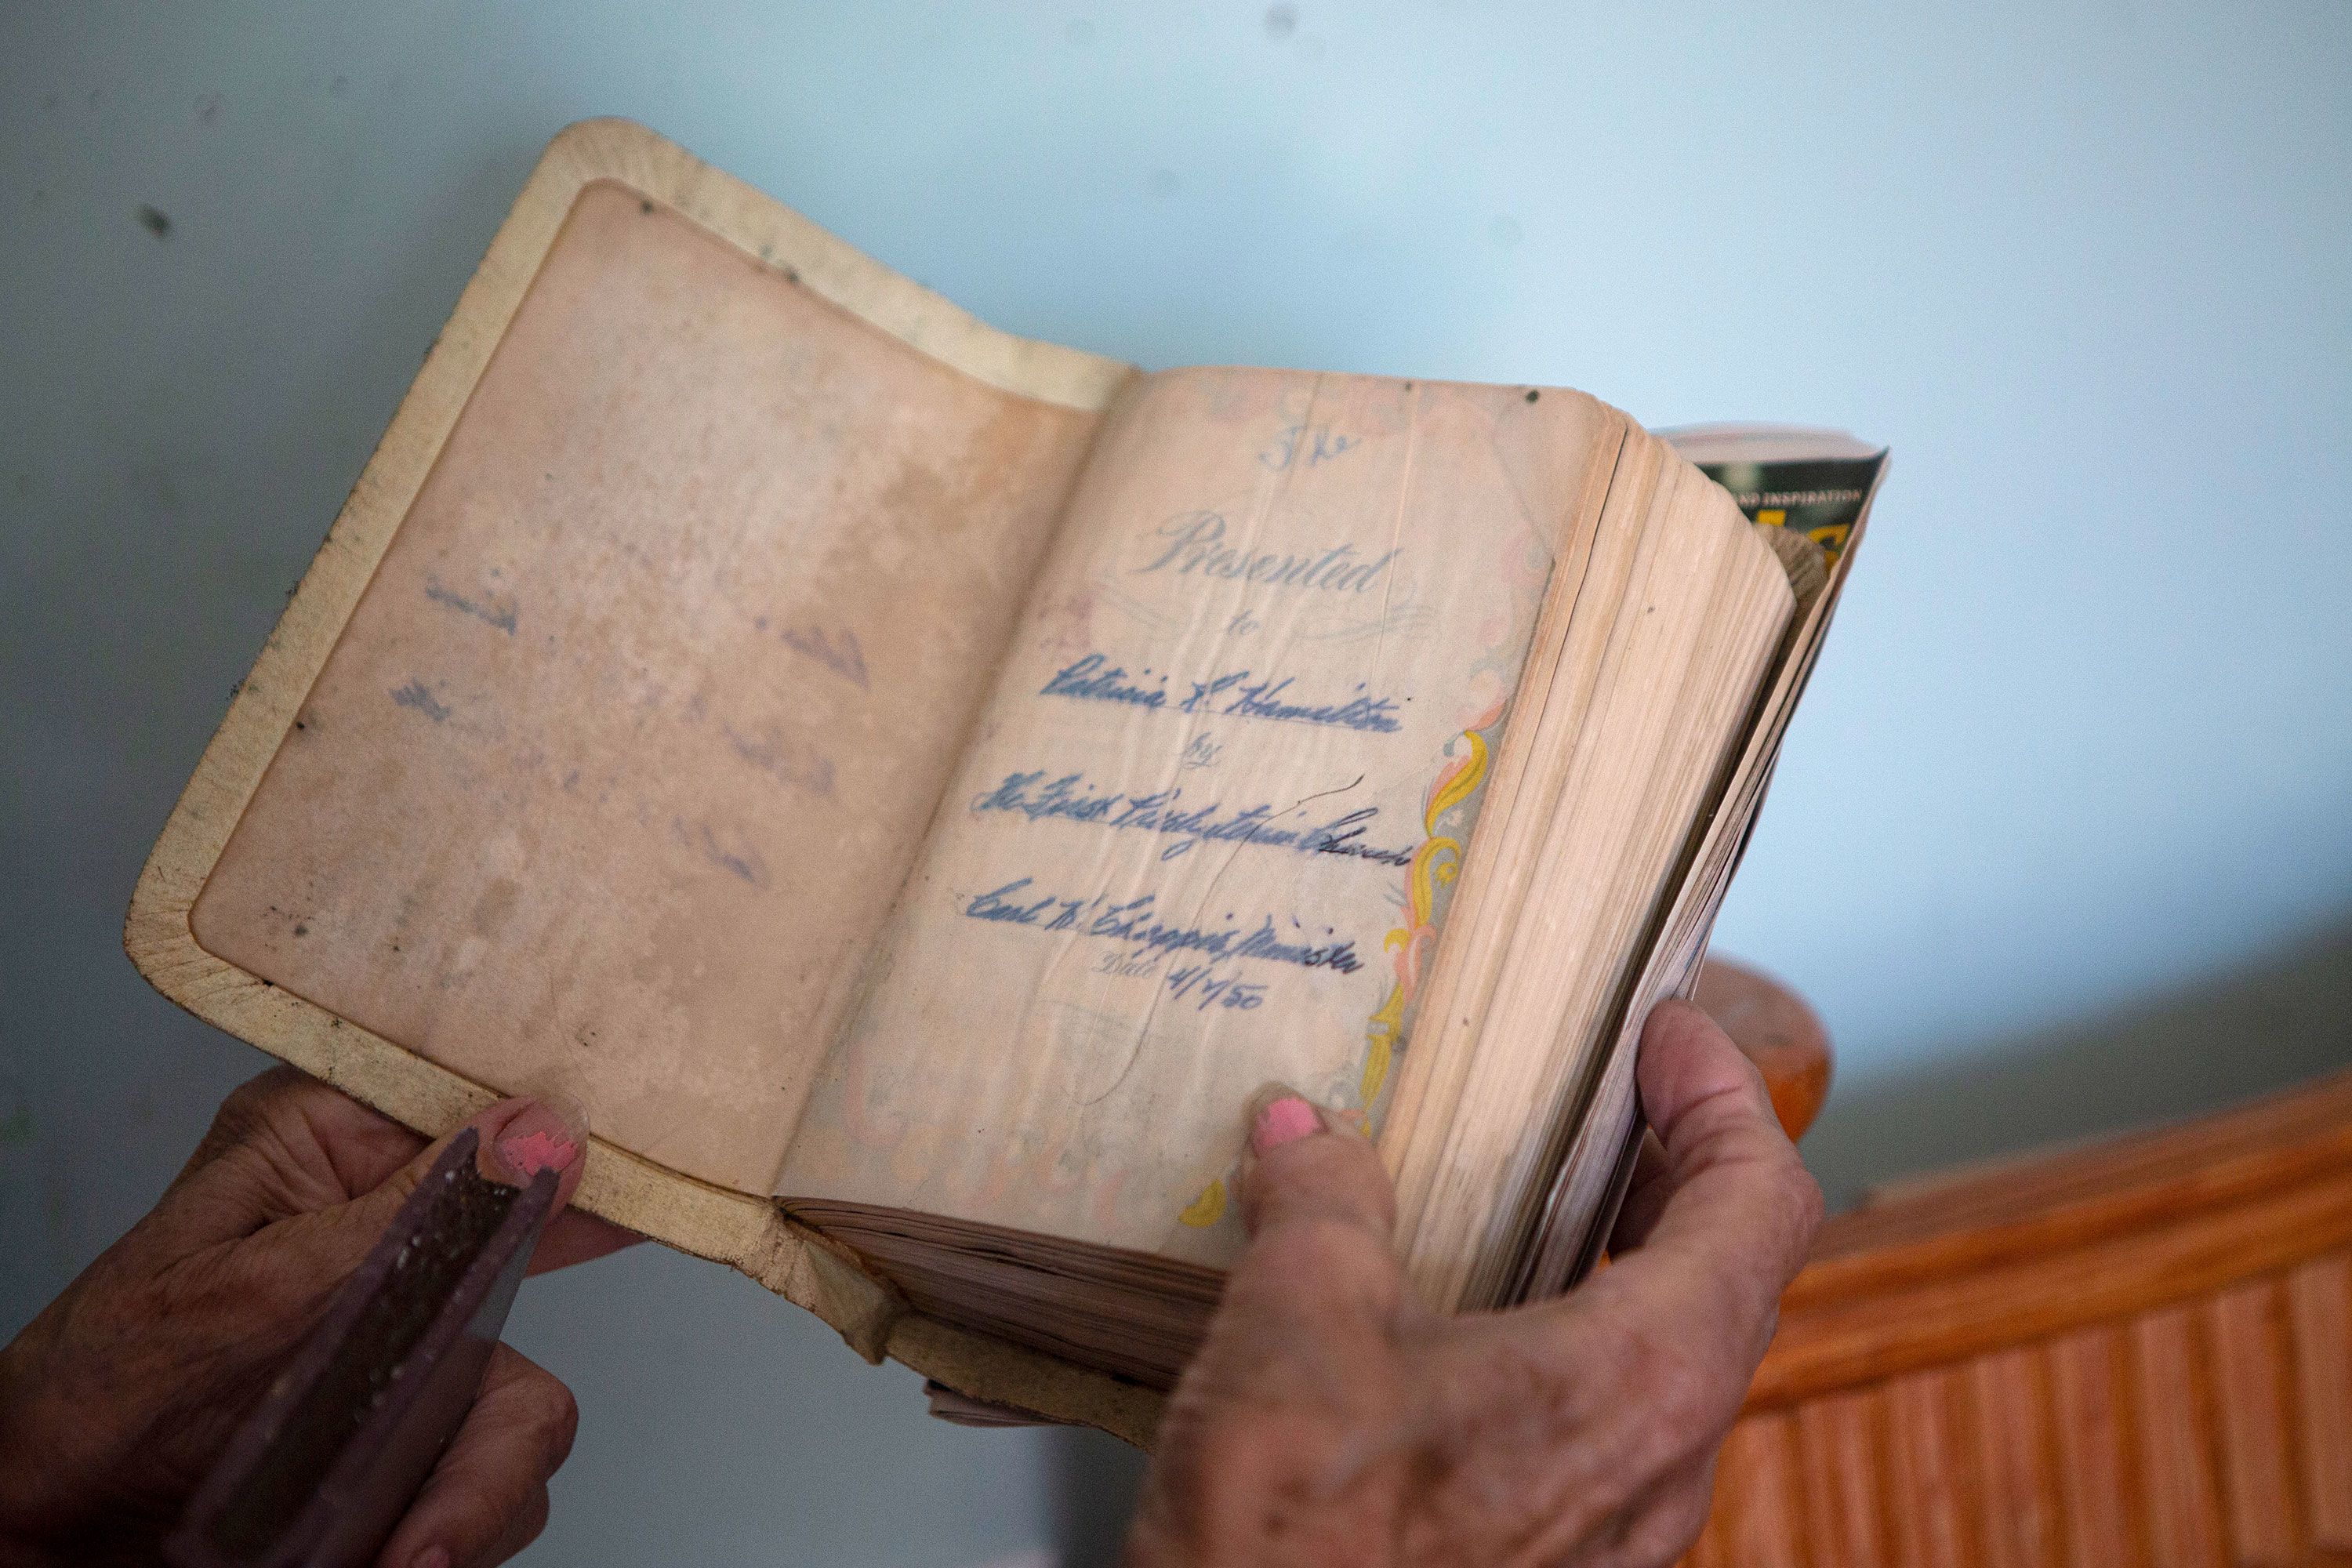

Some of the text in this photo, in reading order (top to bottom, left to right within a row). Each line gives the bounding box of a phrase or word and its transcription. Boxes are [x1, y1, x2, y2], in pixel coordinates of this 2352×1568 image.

[1763, 489, 1862, 506] INSPIRATION
[1129, 510, 1402, 593] Presented
[1226, 608, 1259, 637] to
[1183, 731, 1224, 770] by
[1022, 772, 1124, 821] First
[1109, 788, 1299, 861] Presbyterian
[1298, 807, 1414, 866] Church
